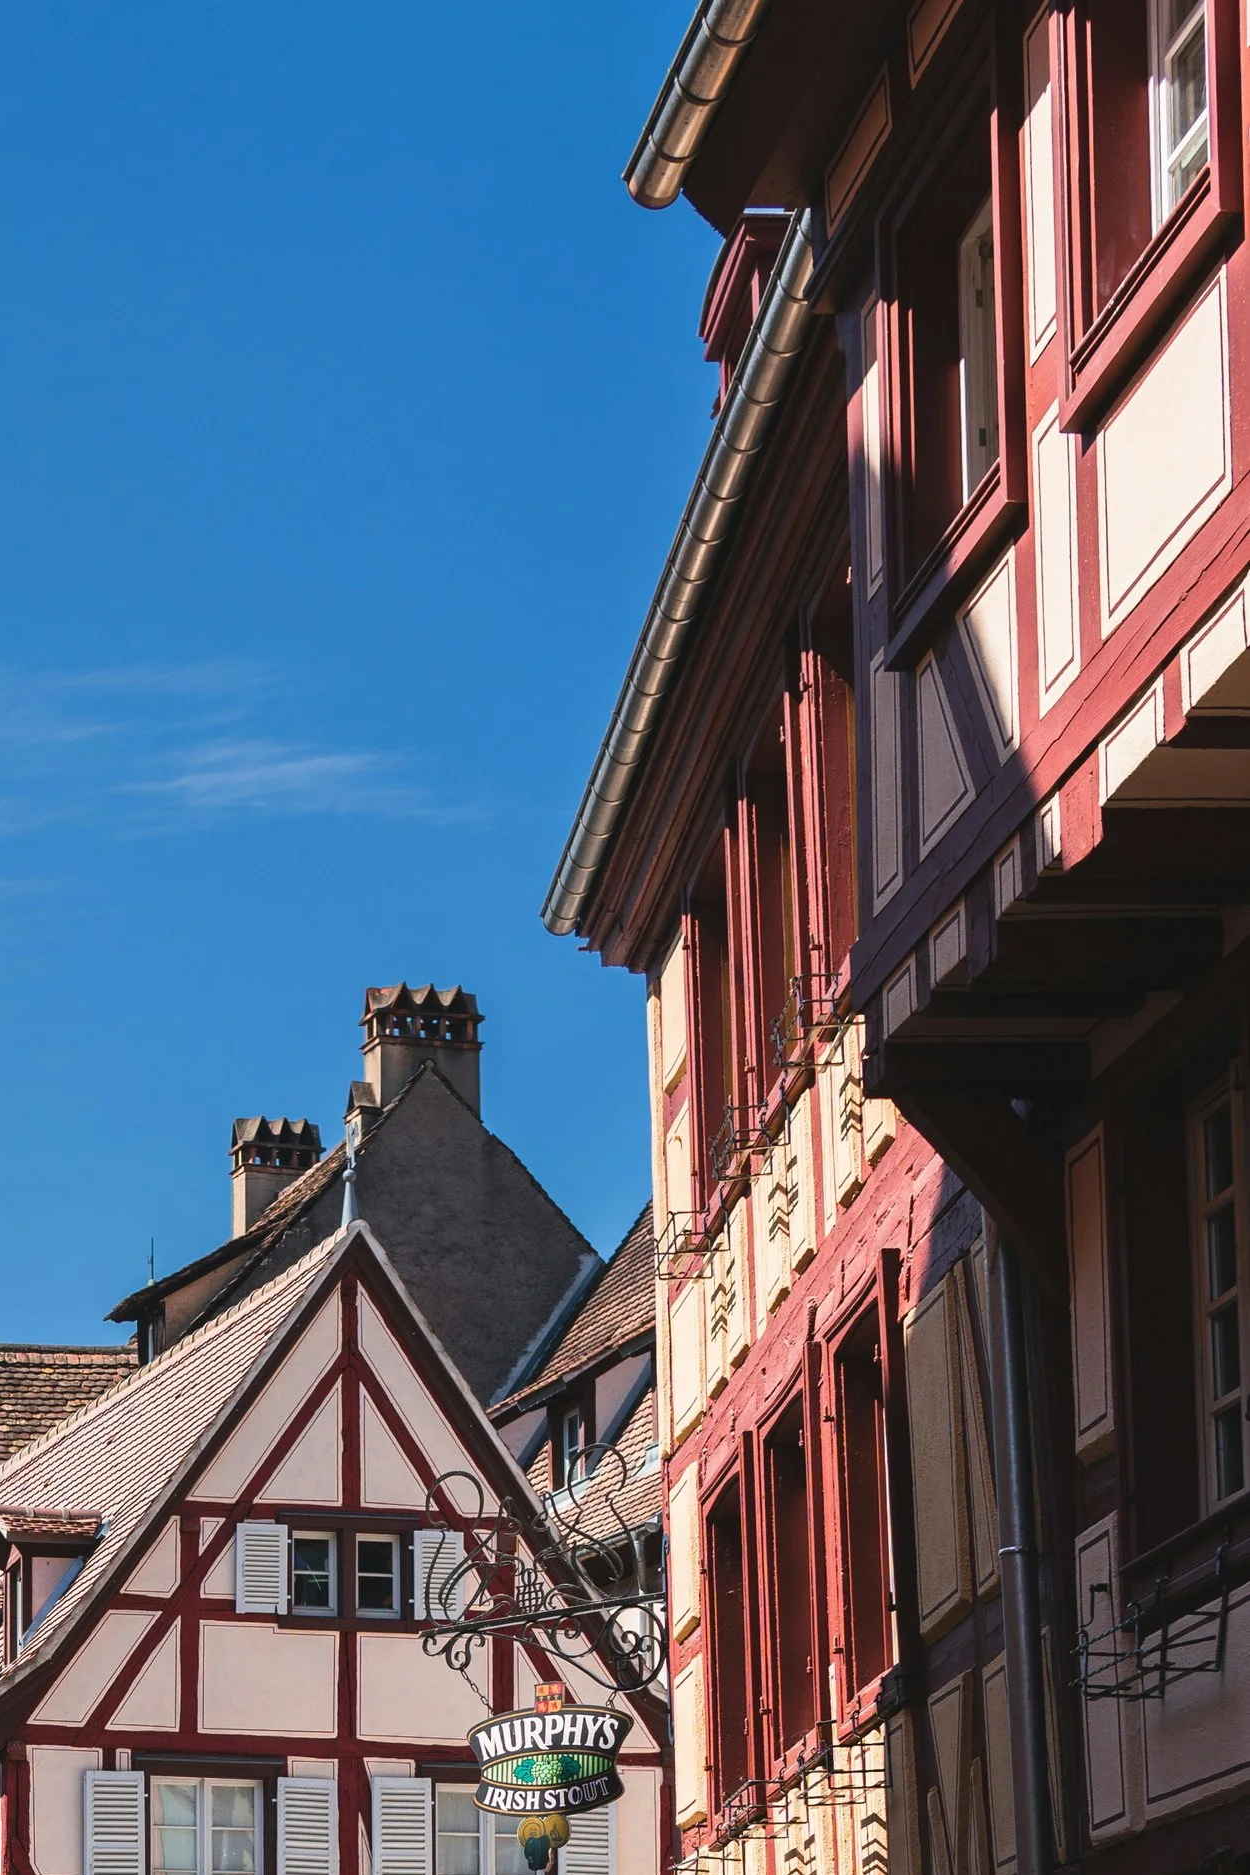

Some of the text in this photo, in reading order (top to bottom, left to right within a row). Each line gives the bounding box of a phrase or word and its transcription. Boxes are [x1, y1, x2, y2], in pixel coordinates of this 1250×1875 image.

[476, 1714, 619, 1760] MURPHY'S
[484, 1778, 608, 1811] IRISH STOUT
